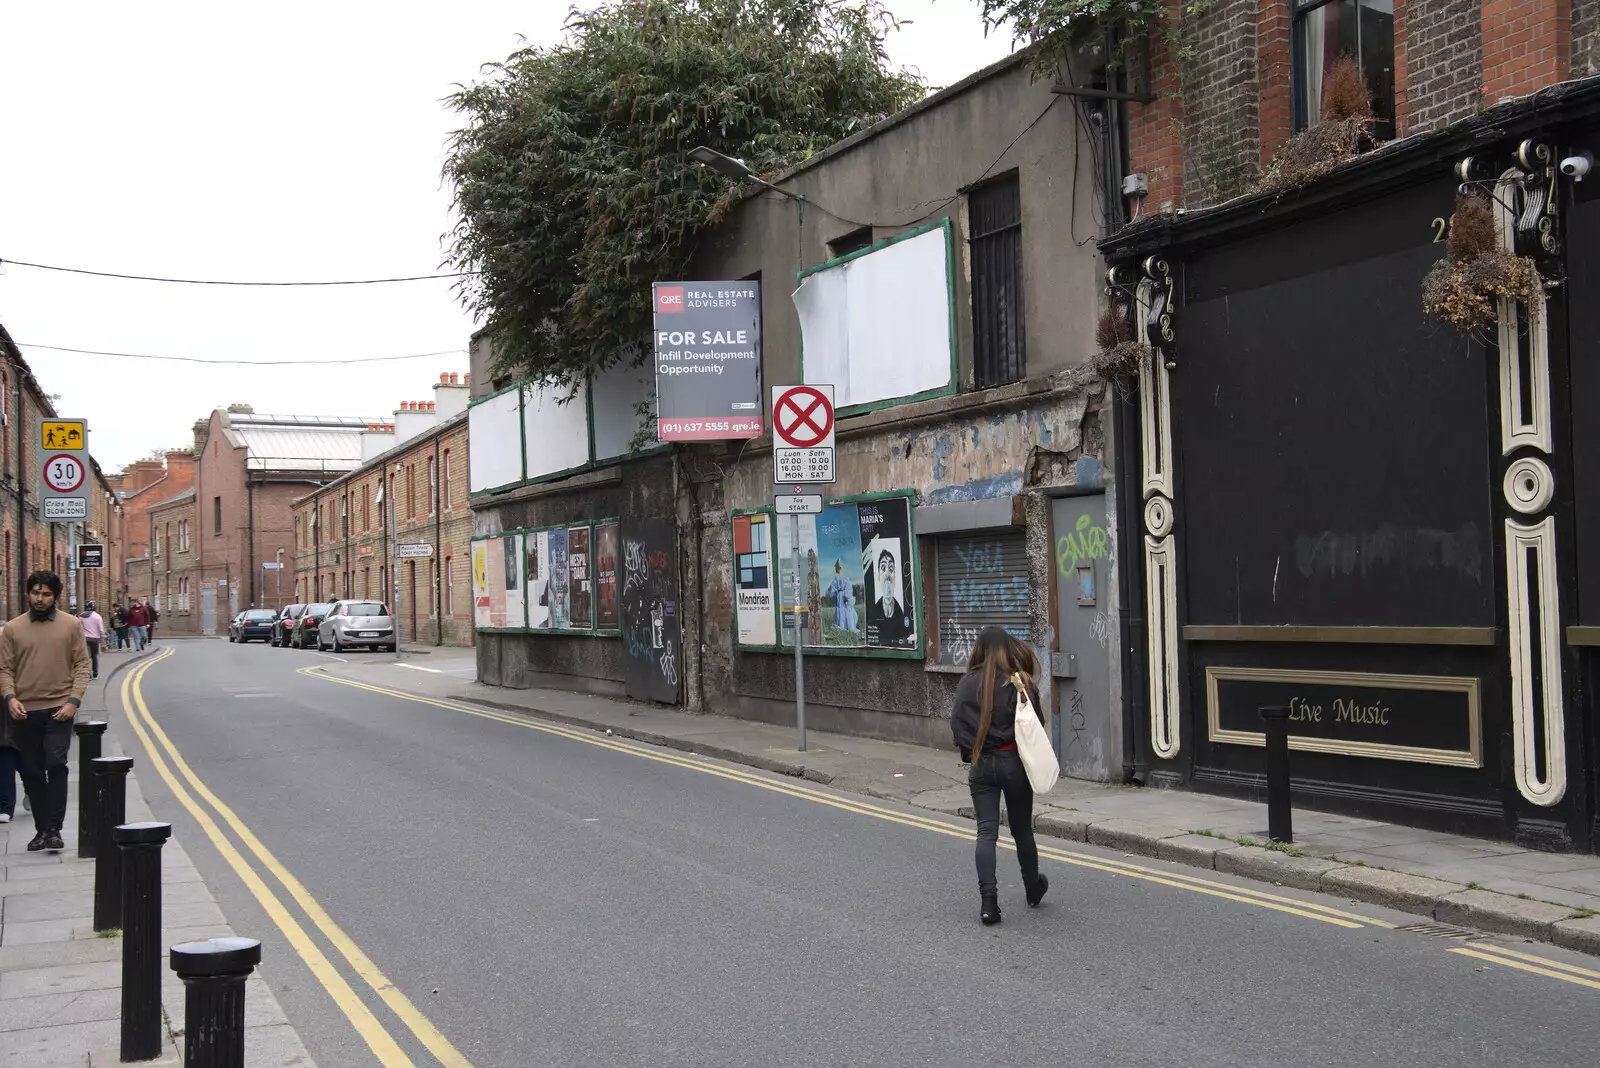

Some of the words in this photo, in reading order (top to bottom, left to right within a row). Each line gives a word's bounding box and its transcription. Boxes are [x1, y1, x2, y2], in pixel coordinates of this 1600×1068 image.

[660, 295, 681, 304] QRE
[687, 291, 714, 299] REAL
[718, 290, 755, 298] ESTATE
[687, 299, 737, 308] ADVISERS
[658, 331, 696, 346] FOR
[702, 330, 747, 345] SALE
[659, 351, 681, 361] Infill
[684, 350, 754, 361] Development
[659, 364, 724, 376] Opportunity
[663, 423, 682, 433] (01)
[683, 423, 702, 432] 637
[705, 421, 729, 431] 5555
[732, 421, 760, 432] qre.ie
[780, 457, 802, 465] 07.00
[54, 463, 74, 479] 30
[810, 471, 825, 479] SAT
[859, 507, 872, 515] THIS
[872, 506, 879, 514] IS
[860, 514, 884, 524] MARIA'S
[738, 592, 769, 605] Mondrian
[1289, 697, 1322, 722] Live
[1333, 699, 1389, 725] Music
